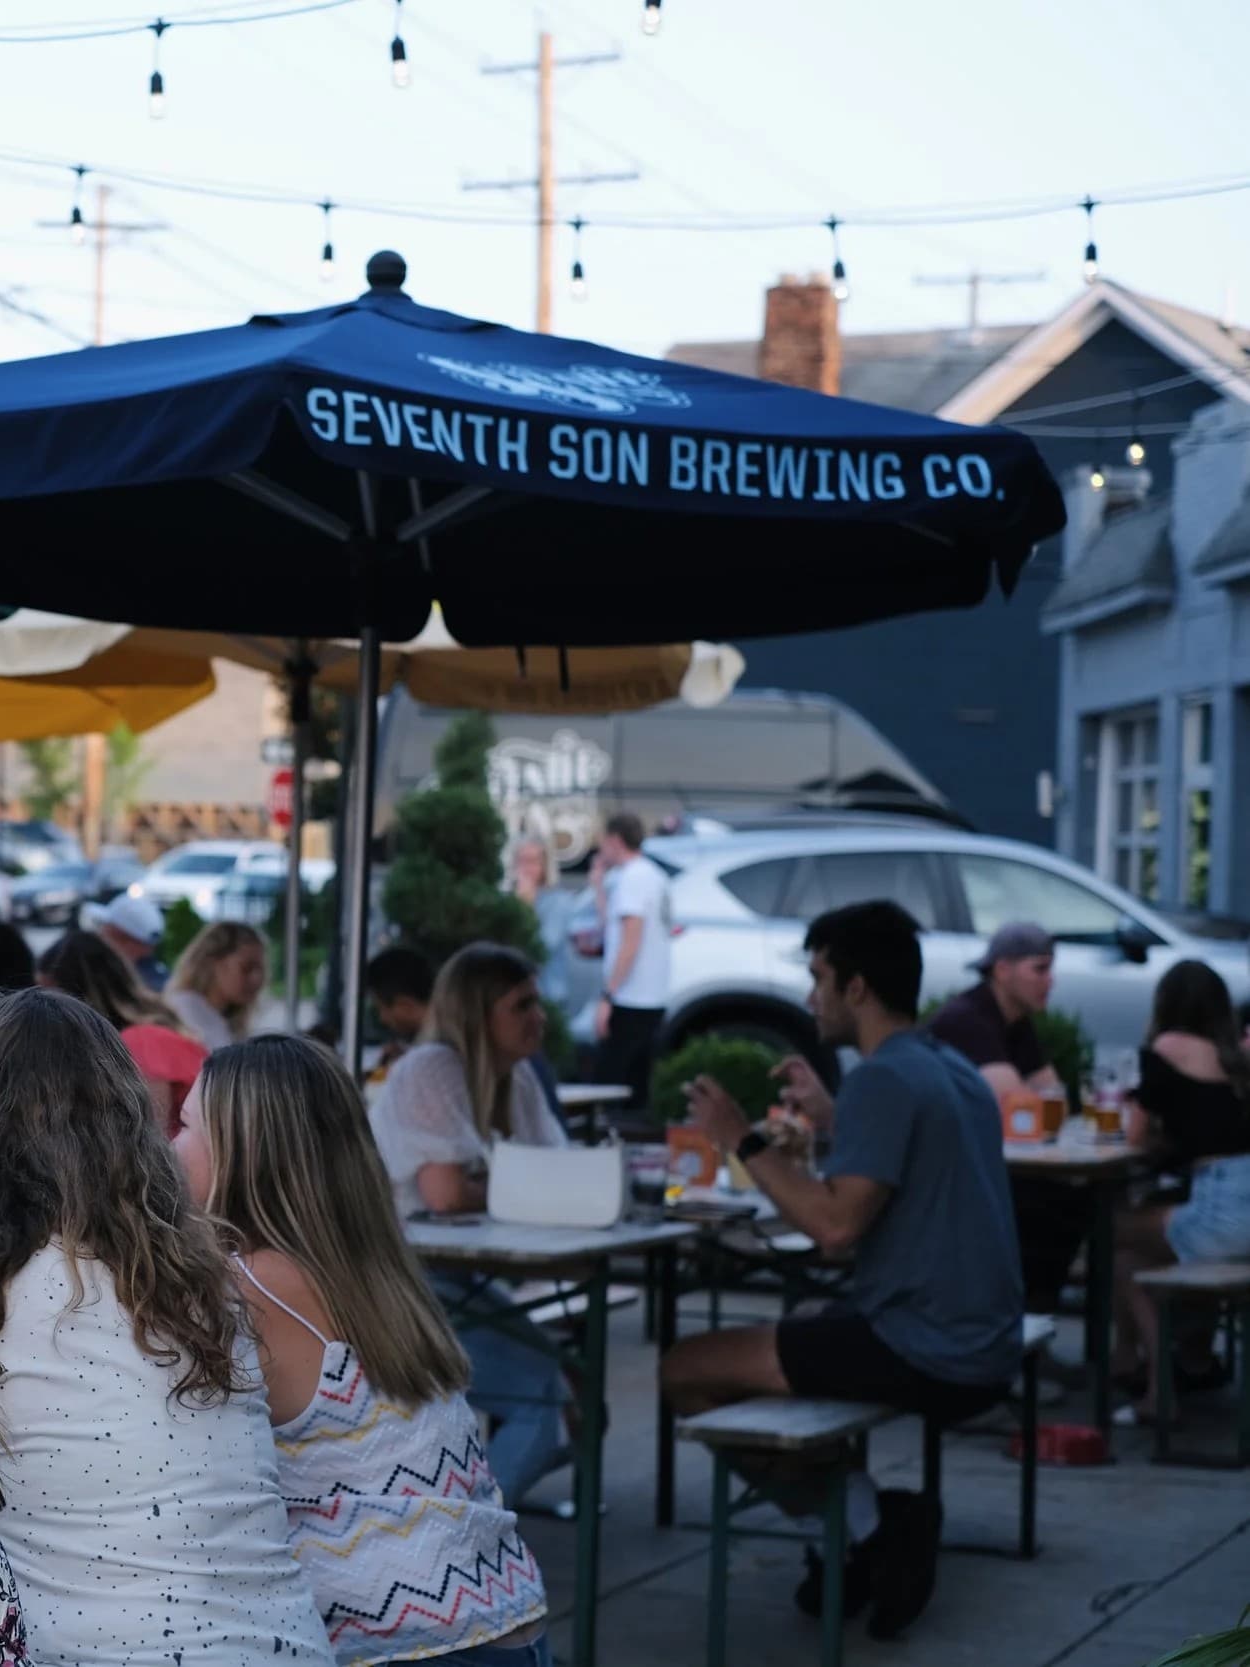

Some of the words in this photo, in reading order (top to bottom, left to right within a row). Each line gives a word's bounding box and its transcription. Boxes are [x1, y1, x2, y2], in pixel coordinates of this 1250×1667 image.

[307, 387, 529, 473] SEVENTH
[549, 425, 649, 486] SON
[669, 436, 906, 501] BREWING
[922, 455, 1007, 501] CO.
